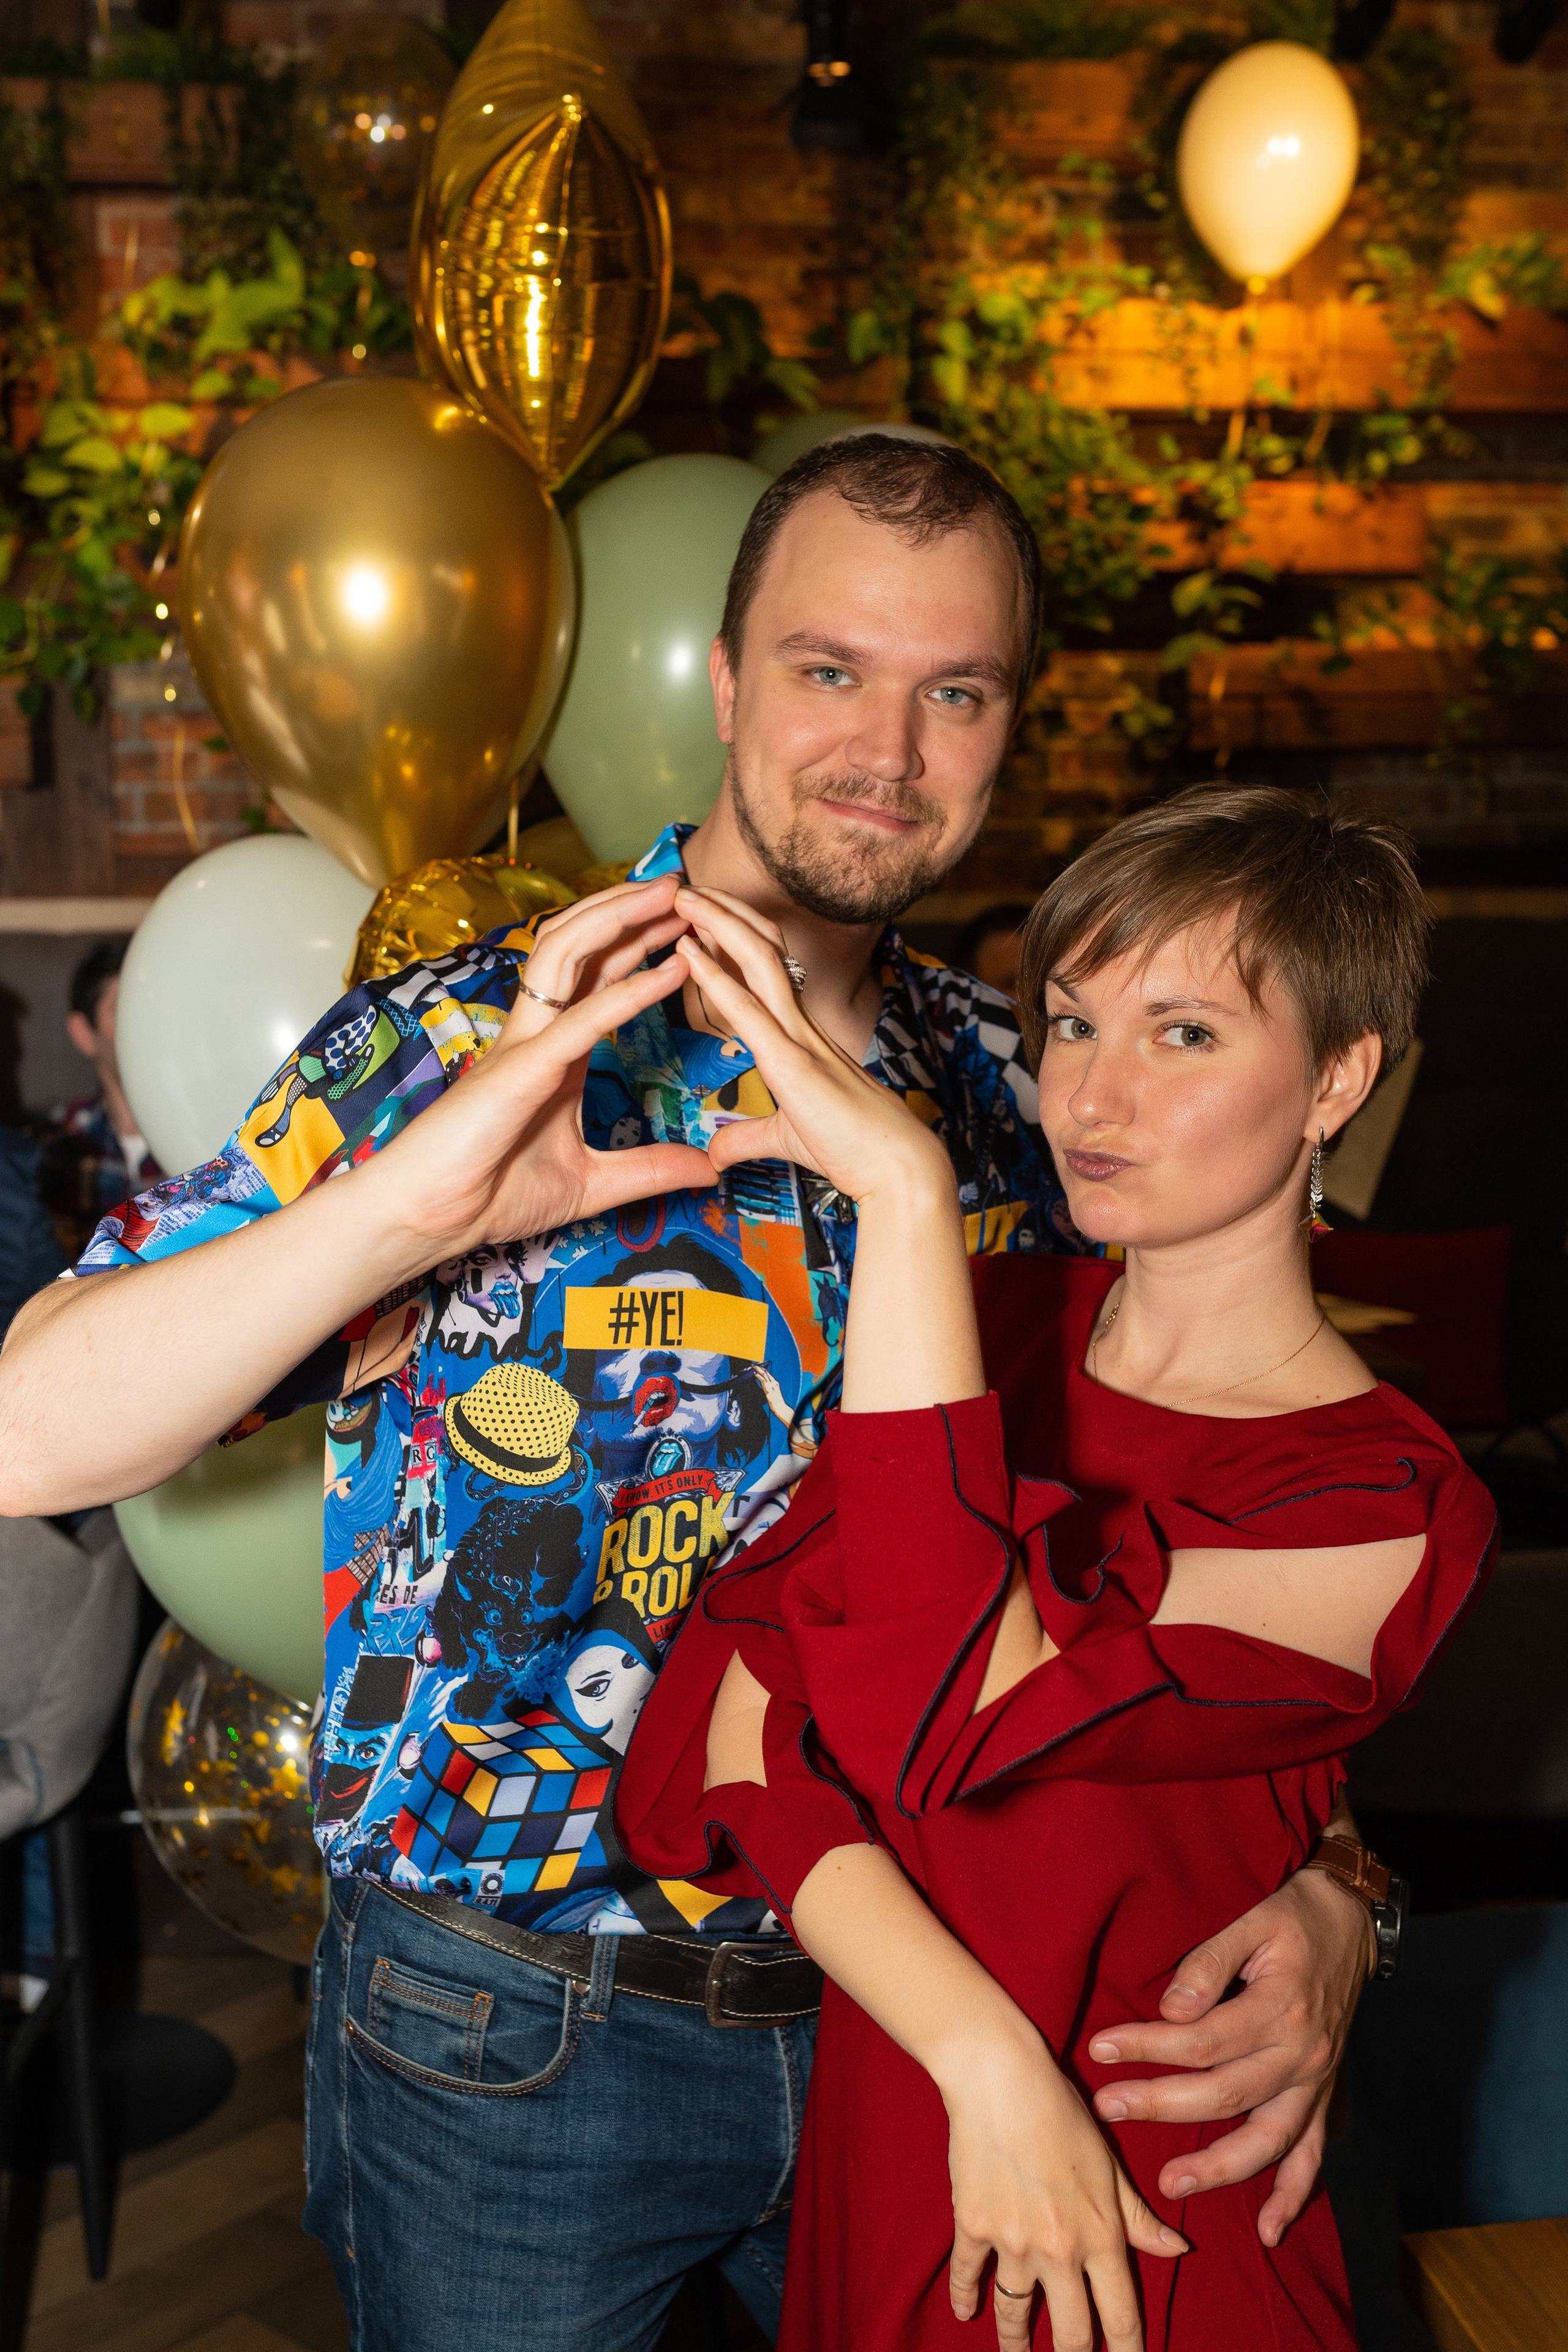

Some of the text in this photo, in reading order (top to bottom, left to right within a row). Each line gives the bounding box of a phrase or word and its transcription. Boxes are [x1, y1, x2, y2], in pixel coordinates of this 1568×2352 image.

[608, 1291, 684, 1346] #YE!
[655, 1479, 673, 1494] IT'S
[676, 1474, 703, 1488] ONLY
[596, 1491, 736, 1585] ROCK
[621, 1556, 715, 1618] ROL
